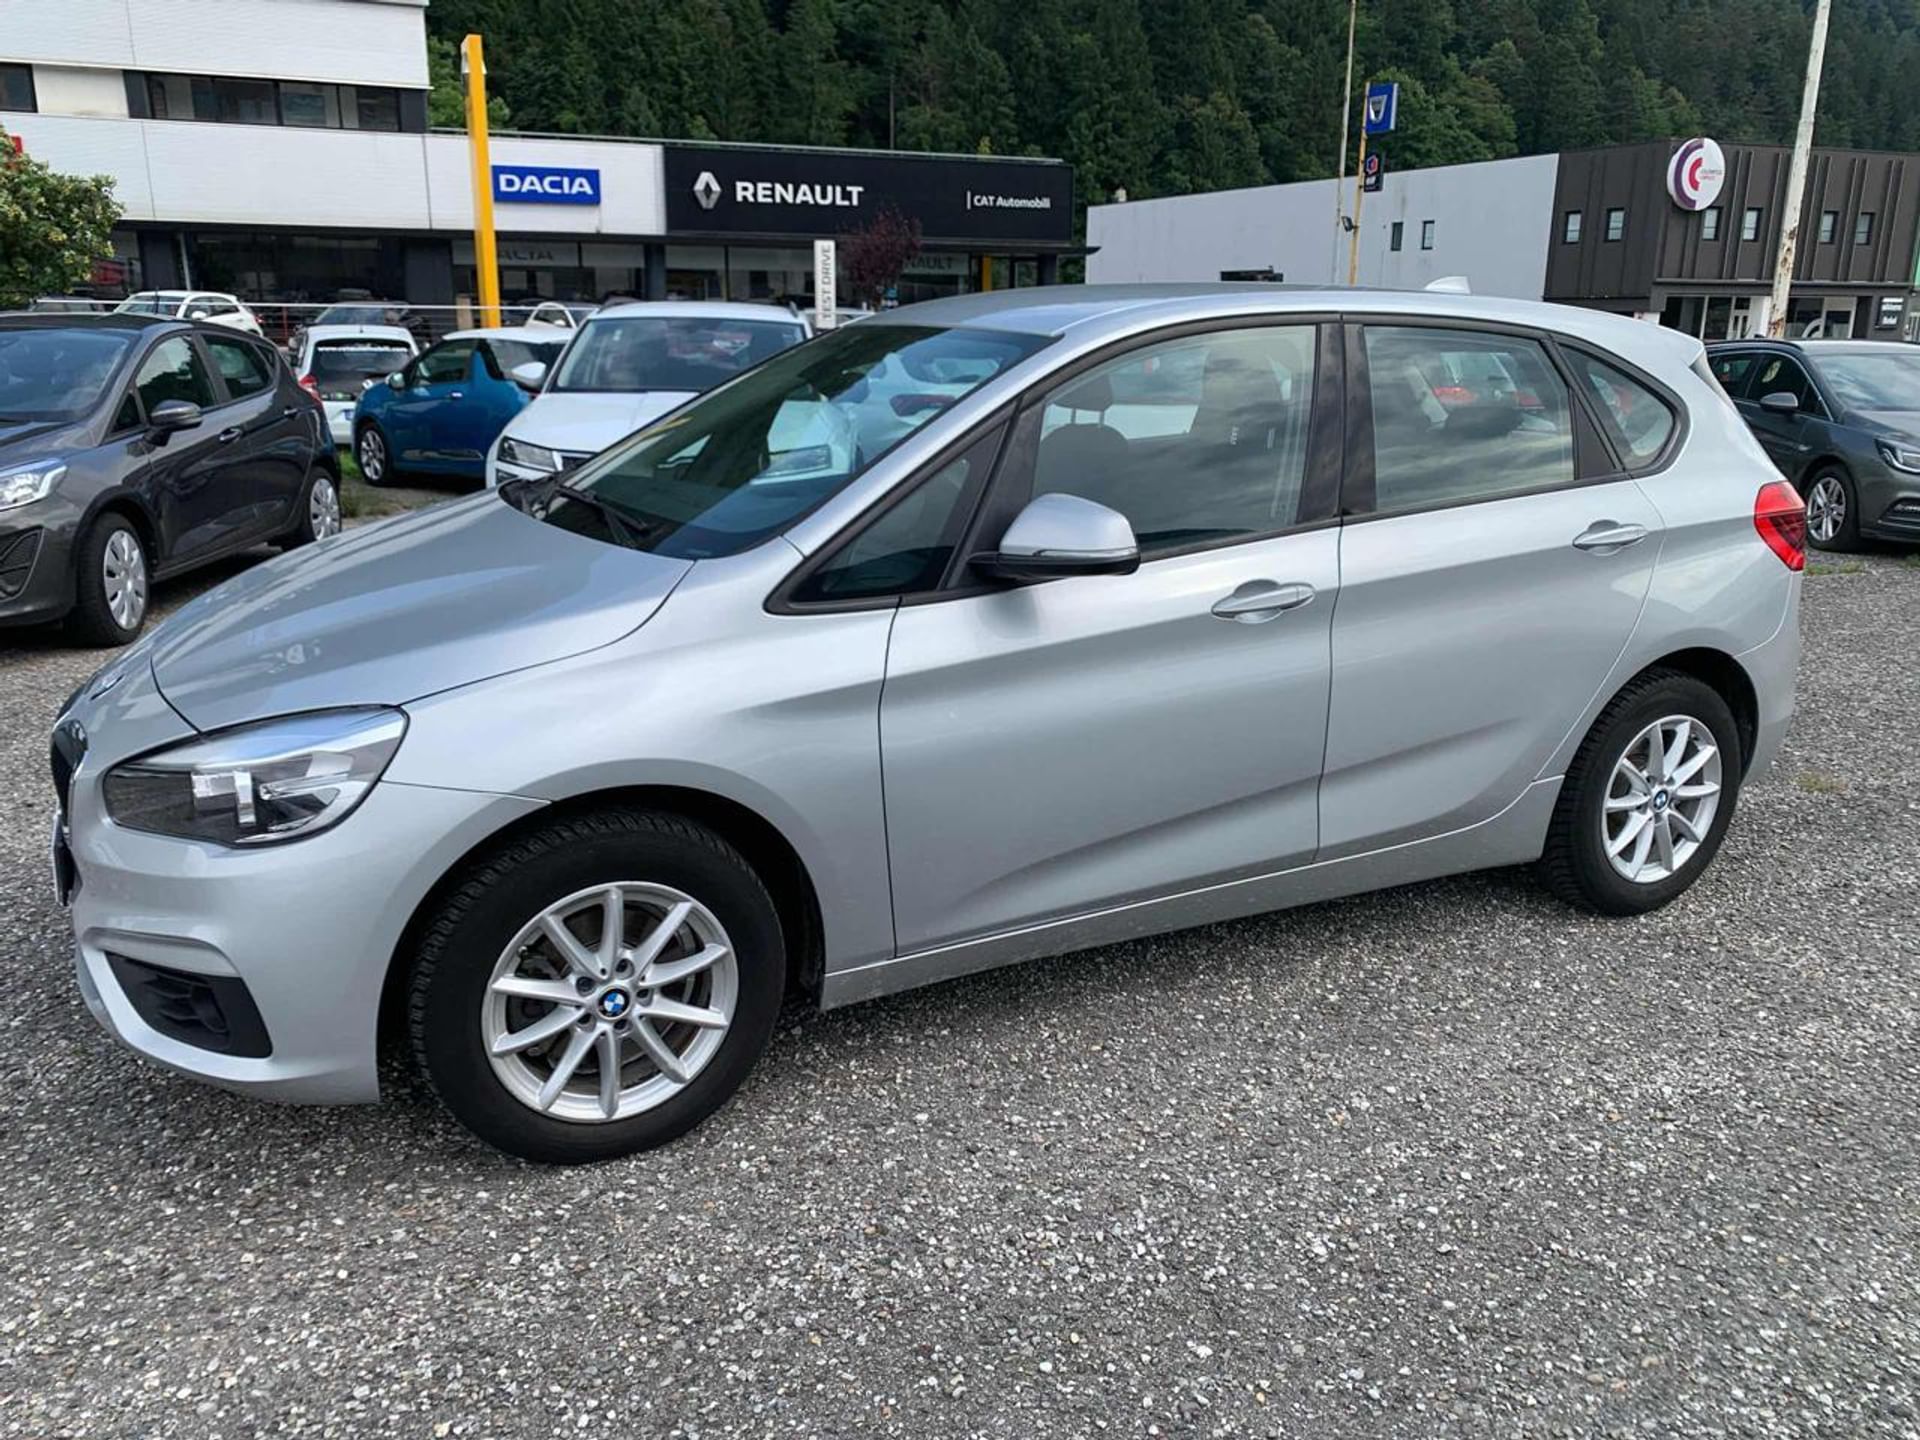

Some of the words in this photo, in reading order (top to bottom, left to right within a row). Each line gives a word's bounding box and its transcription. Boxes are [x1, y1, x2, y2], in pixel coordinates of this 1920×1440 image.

[499, 173, 594, 195] DACIA
[735, 181, 864, 206] RENAULT
[973, 195, 995, 206] CAT
[996, 196, 1051, 208] Automobili
[820, 244, 832, 284] DRIVE
[821, 288, 832, 319] TEST
